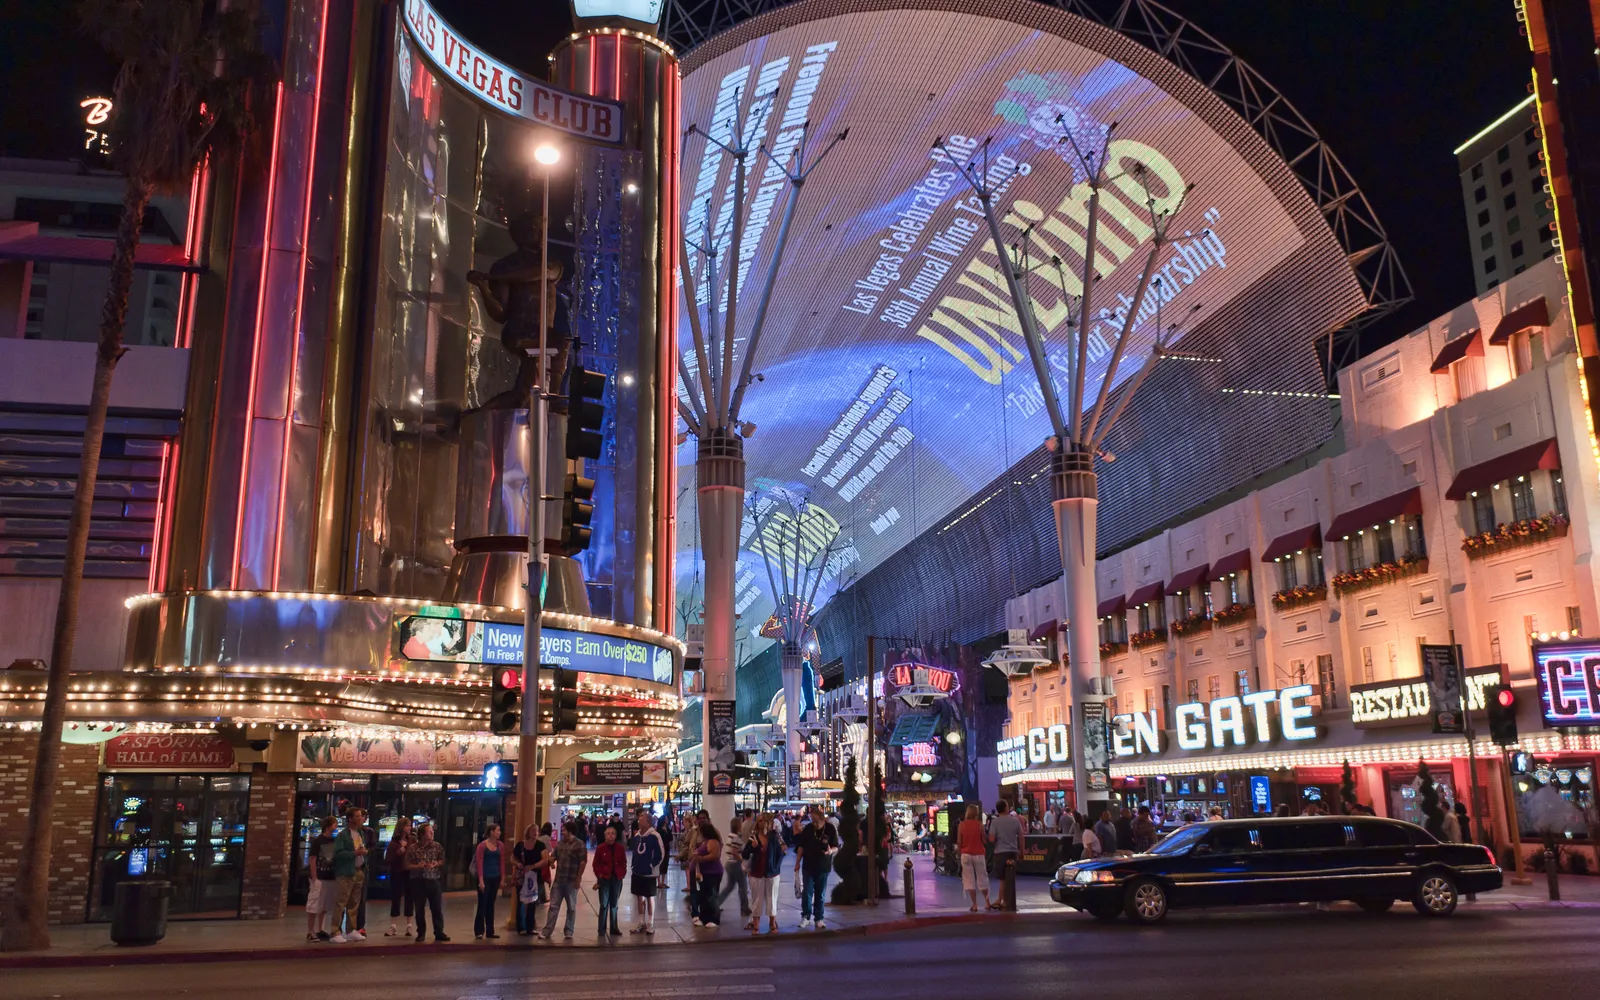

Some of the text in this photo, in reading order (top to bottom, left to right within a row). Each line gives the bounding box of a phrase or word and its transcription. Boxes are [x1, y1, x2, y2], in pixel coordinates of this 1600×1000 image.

[407, 0, 437, 51] LAS
[441, 27, 523, 111] VEGAS
[532, 87, 612, 138] CLUB
[755, 56, 790, 98] the
[780, 41, 838, 130] Fremont
[761, 128, 804, 185] Street
[739, 182, 785, 262] Experience
[843, 134, 978, 315] Las Vegas Celebrates the
[927, 217, 980, 257] Wine
[899, 252, 953, 302] Annual
[880, 299, 921, 329] 36th
[829, 400, 871, 441] Experience
[816, 434, 843, 457] Street
[487, 628, 648, 664] New ayers Earn Over $250
[487, 648, 495, 659] In
[497, 650, 515, 661] Free
[546, 652, 571, 666] Comps.
[896, 666, 911, 685] LA
[1175, 684, 1318, 751] GATE
[1350, 671, 1500, 724] RESTAUNT
[115, 750, 224, 764] HALL of FAME
[131, 736, 209, 749] SPORTS
[329, 746, 400, 765] Welcome
[402, 750, 420, 765] to
[422, 750, 446, 766] the
[450, 750, 490, 768] Vegas
[909, 744, 937, 766] THE NEXT
[997, 748, 1027, 774] CASINO
